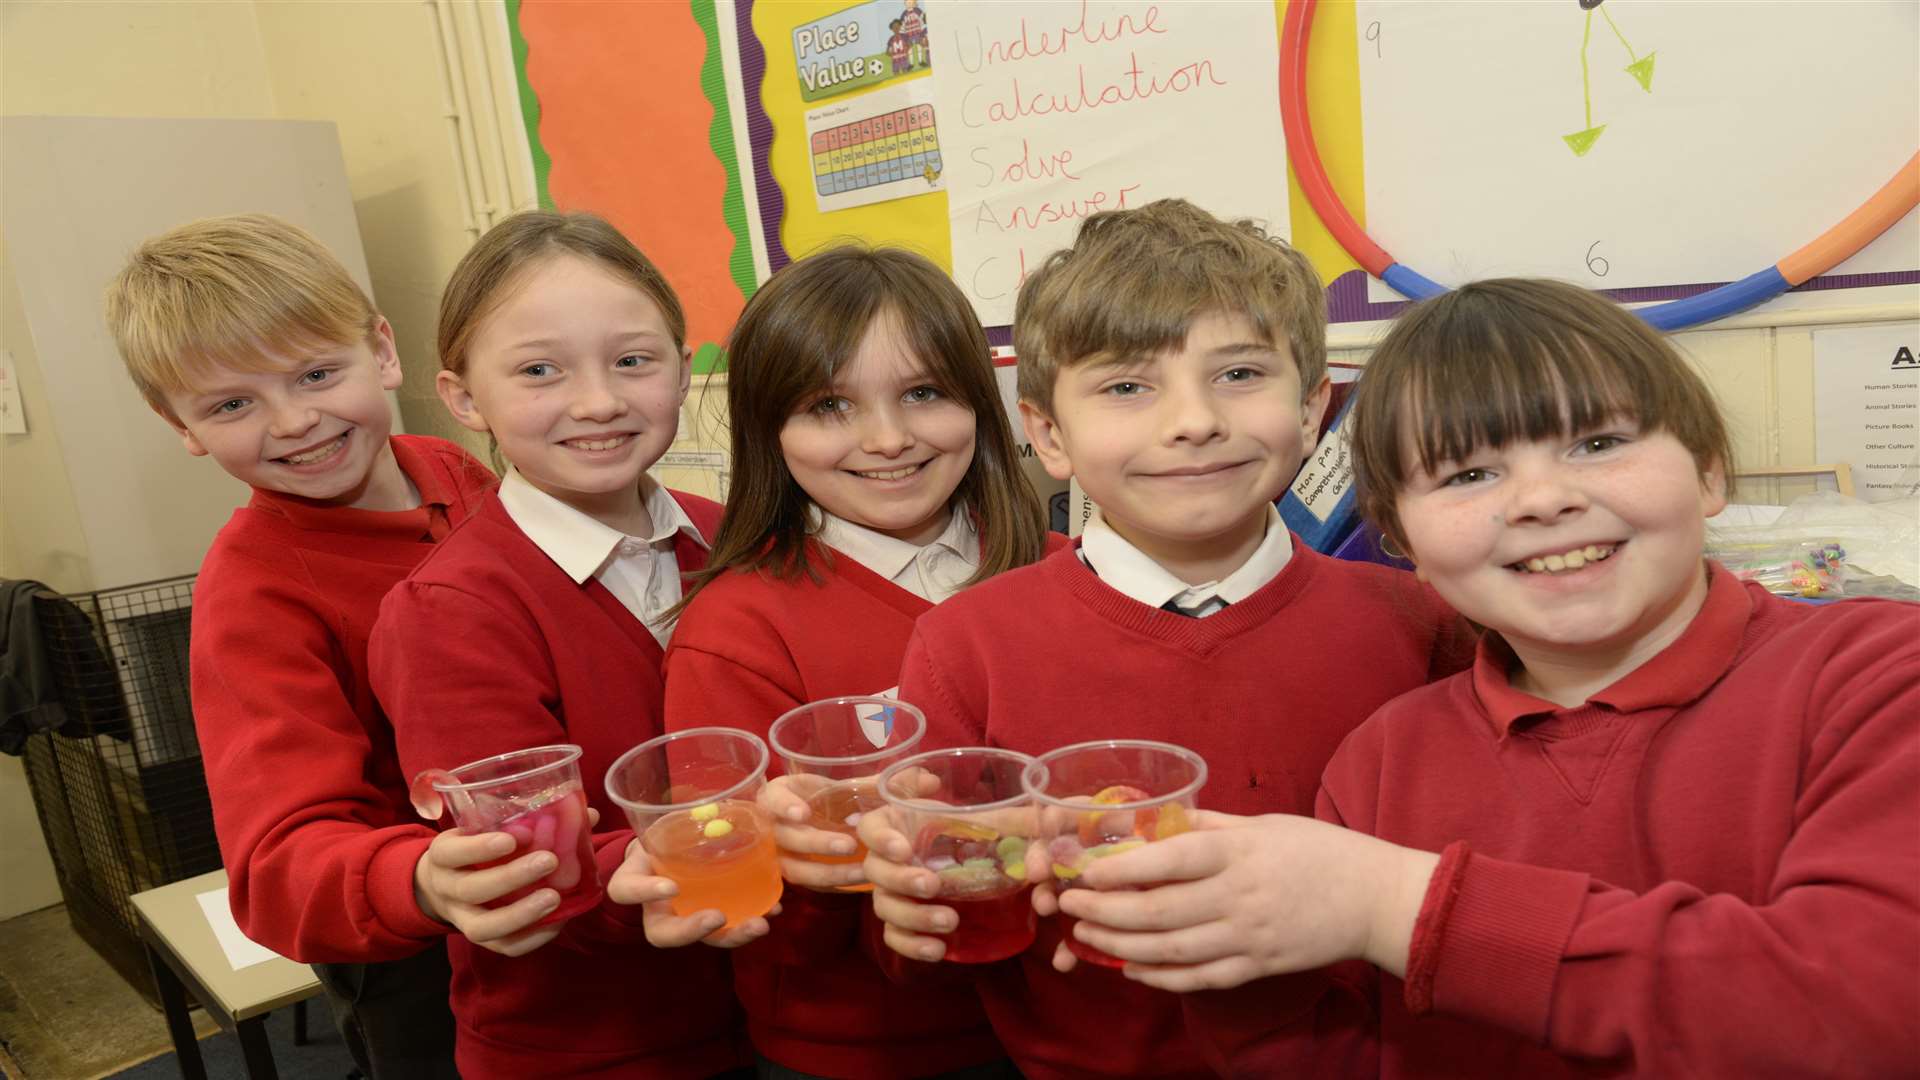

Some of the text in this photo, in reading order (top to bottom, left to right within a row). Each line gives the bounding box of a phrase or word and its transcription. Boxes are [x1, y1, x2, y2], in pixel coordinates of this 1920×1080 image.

[797, 21, 859, 60] Place
[955, 0, 1168, 73] Underline
[800, 57, 864, 92] Value
[961, 51, 1227, 128] Calculation
[841, 130, 849, 141] 2
[853, 128, 859, 139] 3
[863, 126, 870, 136] 4
[875, 122, 881, 133] 5
[886, 120, 893, 130] 6
[897, 116, 904, 127] 7
[910, 113, 917, 124] 8
[922, 111, 929, 122] 9
[970, 138, 1080, 188] Solve
[975, 184, 1141, 232] Answer
[1586, 240, 1609, 277] 6
[1892, 346, 1920, 365] A
[1864, 383, 1890, 391] Human
[1891, 402, 1917, 410] Stories
[1297, 472, 1315, 495] Mon
[1866, 482, 1892, 490] Fantasy
